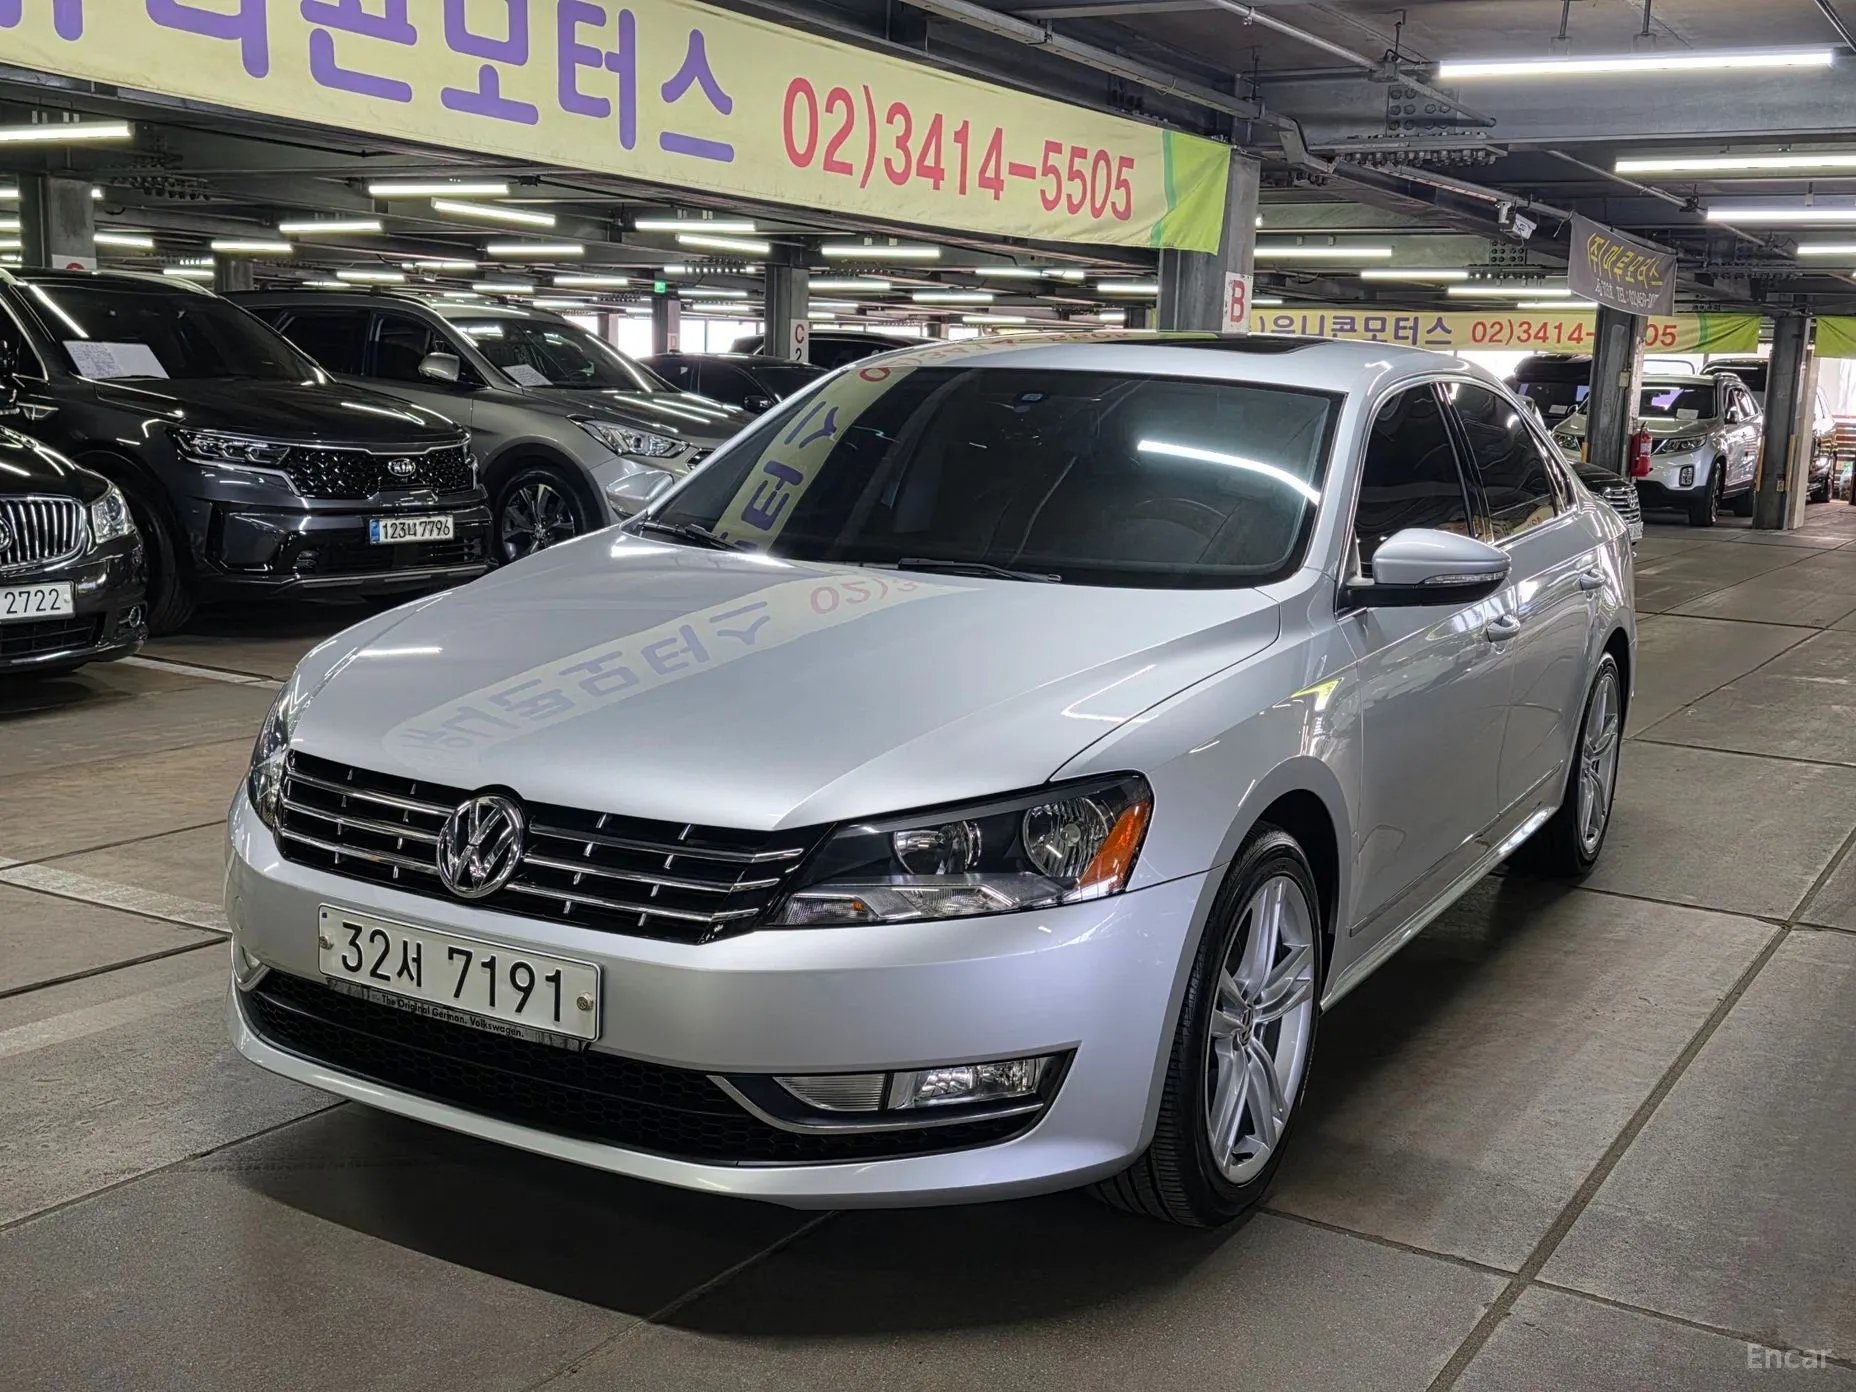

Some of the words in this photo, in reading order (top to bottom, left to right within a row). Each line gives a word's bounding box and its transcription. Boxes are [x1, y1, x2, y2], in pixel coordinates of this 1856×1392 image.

[0, 0, 734, 163] 콘모터스
[782, 76, 1135, 221] 02)3414-5505
[1230, 279, 1245, 323] B
[795, 323, 805, 344] C
[1471, 319, 1678, 346] 02)3414-05
[4, 588, 61, 615] 2722
[341, 920, 423, 988] 32서
[447, 945, 562, 1023] 7191
[382, 994, 396, 1006] The
[397, 998, 430, 1016] Original
[431, 1006, 468, 1025] German.
[469, 1015, 525, 1038] Volkswagen.
